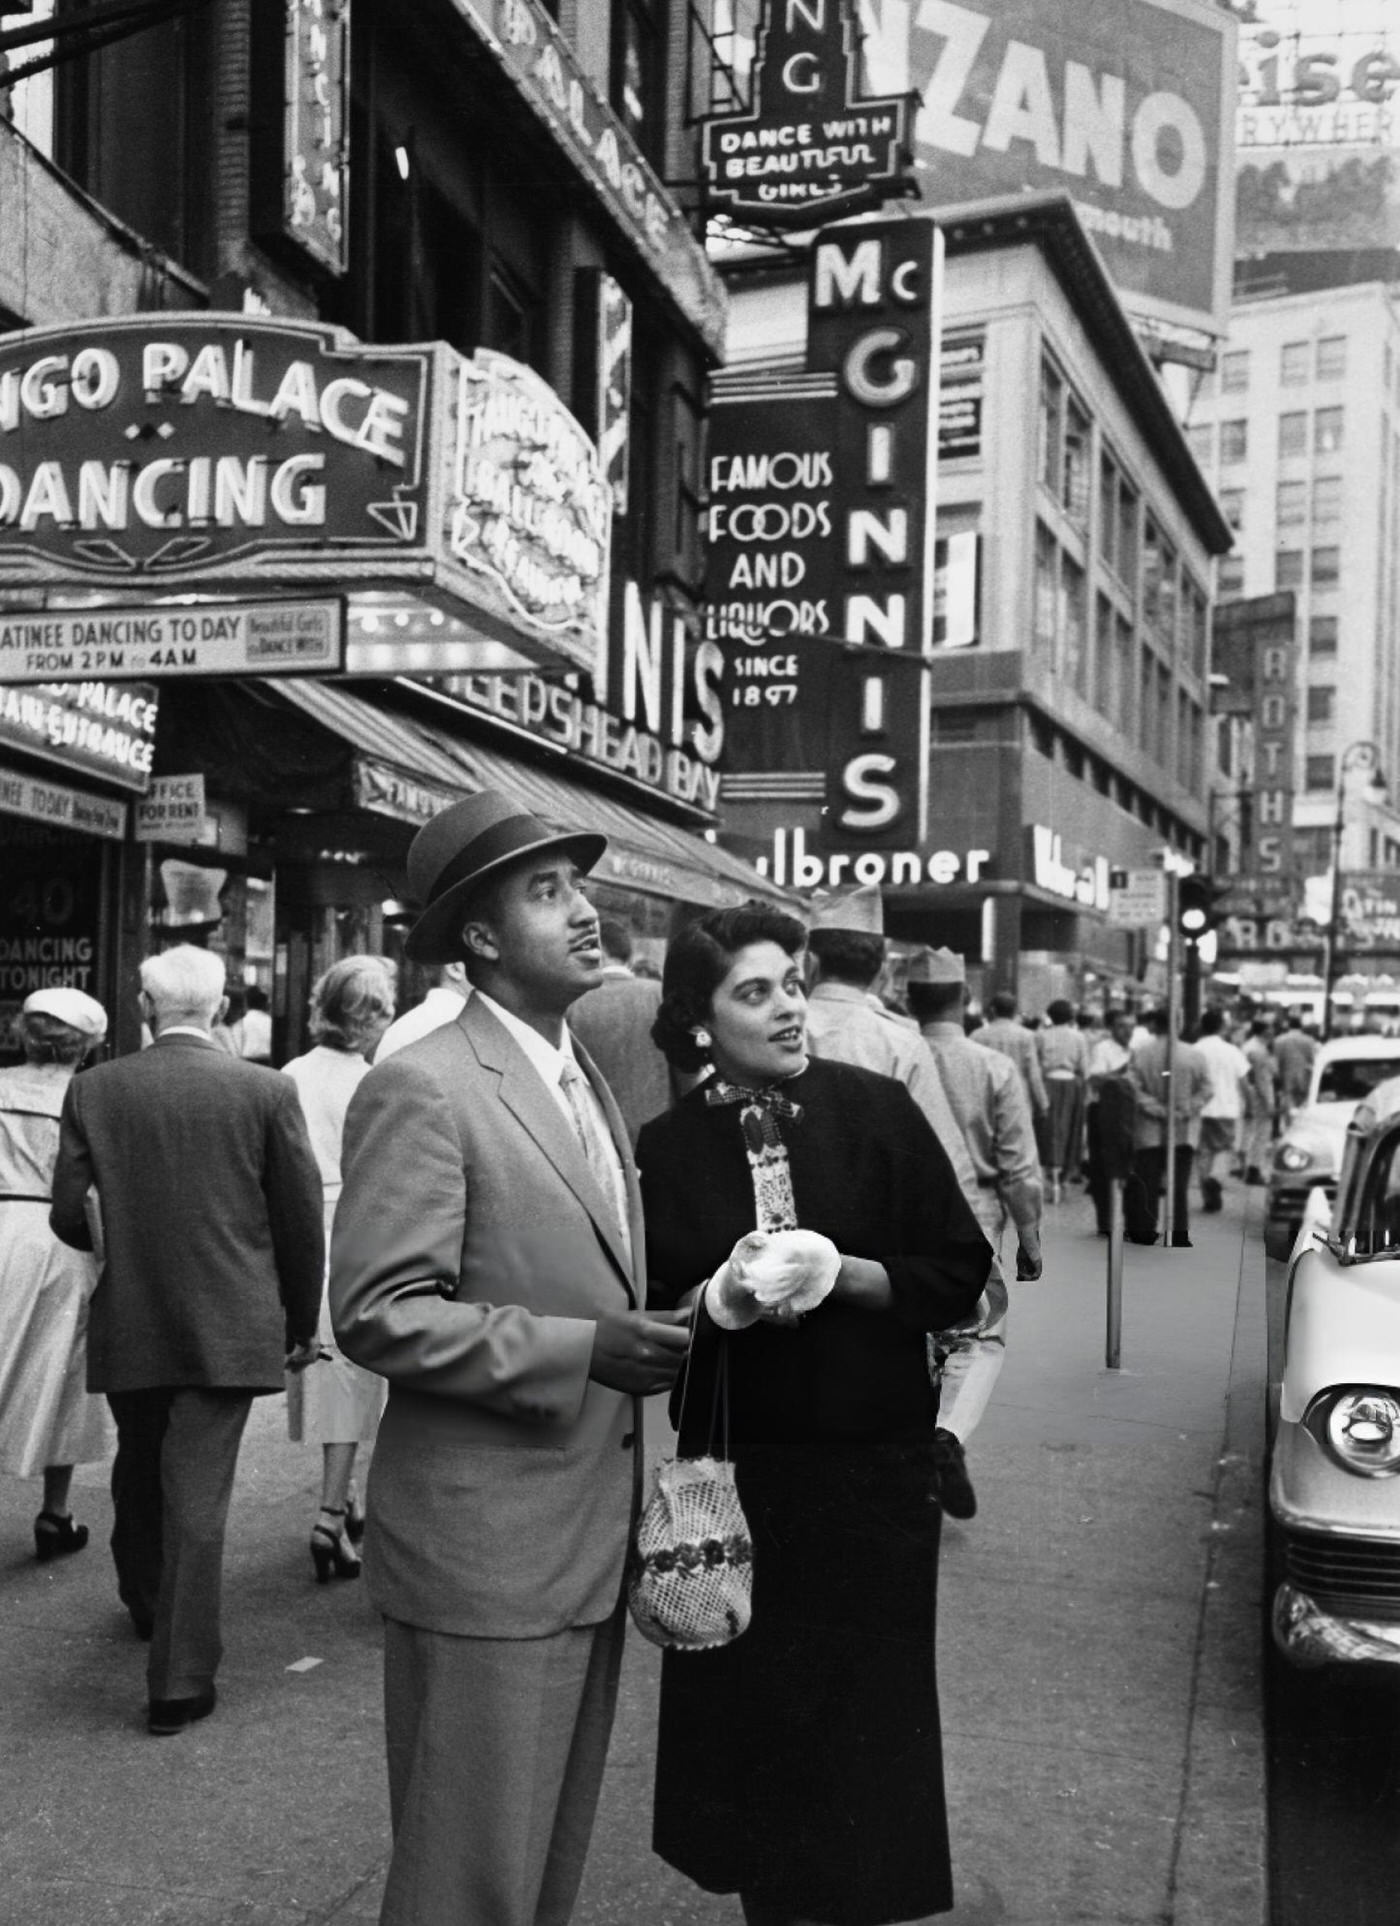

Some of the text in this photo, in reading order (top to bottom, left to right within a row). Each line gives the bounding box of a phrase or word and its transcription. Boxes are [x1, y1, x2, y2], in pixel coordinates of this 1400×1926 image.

[721, 117, 891, 153] DANCE WITH
[726, 144, 876, 178] BEAUTIFUL
[143, 339, 408, 467] PALACE
[711, 452, 833, 492] FAMOUS
[709, 501, 832, 543] FOODS
[729, 551, 805, 588] AND
[71, 619, 163, 648] DANCING
[706, 599, 829, 646] LIQUORS
[26, 651, 74, 672] FROM
[734, 655, 798, 677] SINCE
[77, 682, 158, 734] PALACE
[732, 685, 798, 706] 1897
[150, 781, 195, 799] FFICE
[668, 749, 720, 811] BAY
[140, 804, 166, 820] FOR
[169, 802, 199, 818] RENT
